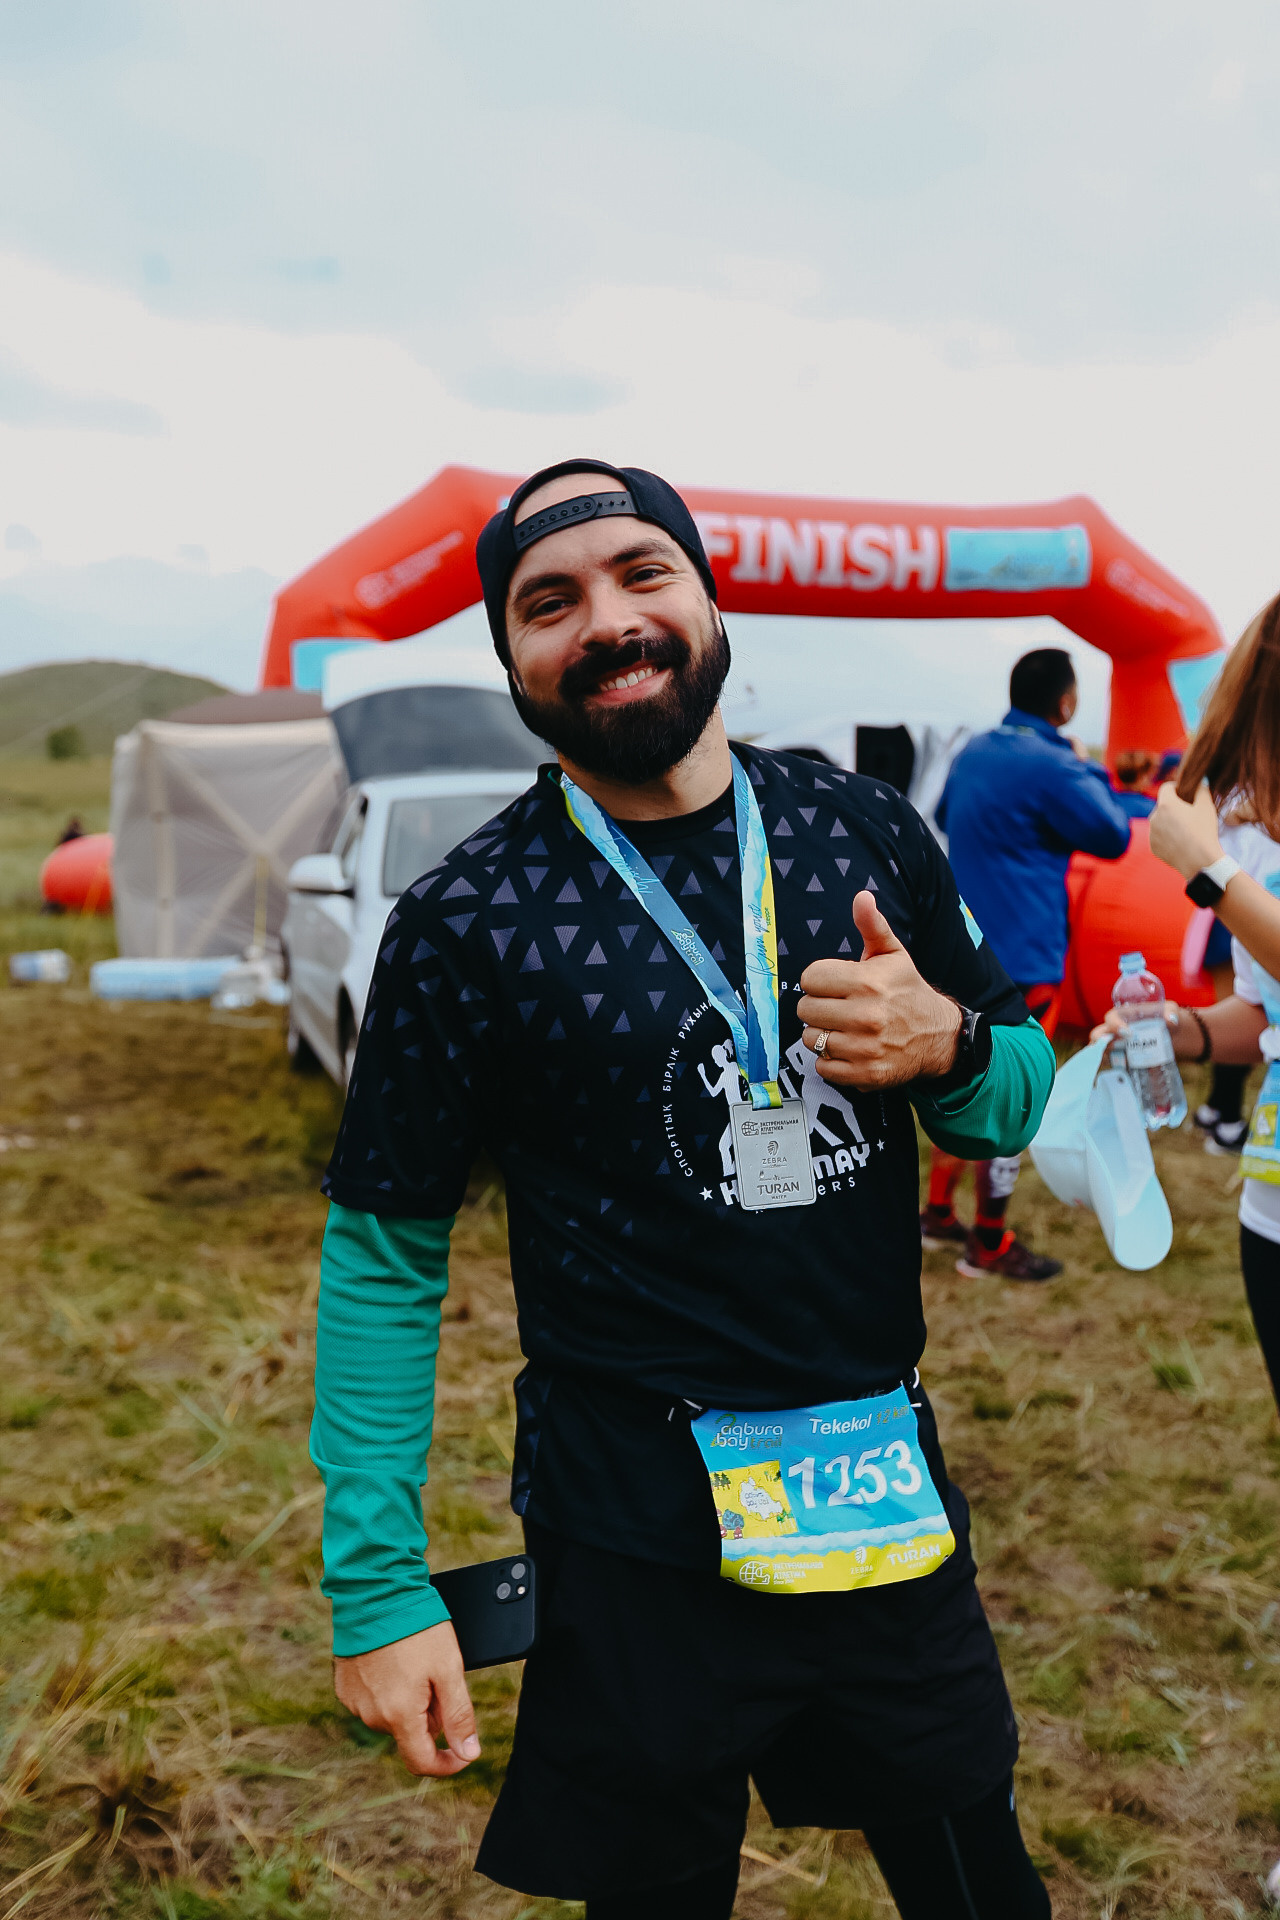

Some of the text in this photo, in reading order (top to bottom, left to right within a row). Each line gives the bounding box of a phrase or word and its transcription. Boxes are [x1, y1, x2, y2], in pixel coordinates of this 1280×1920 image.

[692, 510, 940, 593] FINISH
[744, 904, 778, 976] Run your
[762, 1156, 788, 1165] ZEBRA
[757, 1181, 800, 1195] TURAN
[808, 1413, 873, 1435] Tekekol
[876, 1407, 891, 1425] 12
[716, 1432, 783, 1451] bay trail
[788, 1440, 922, 1509] 1253
[886, 1543, 942, 1567] TURAN
[850, 1564, 874, 1575] ZEBRA
